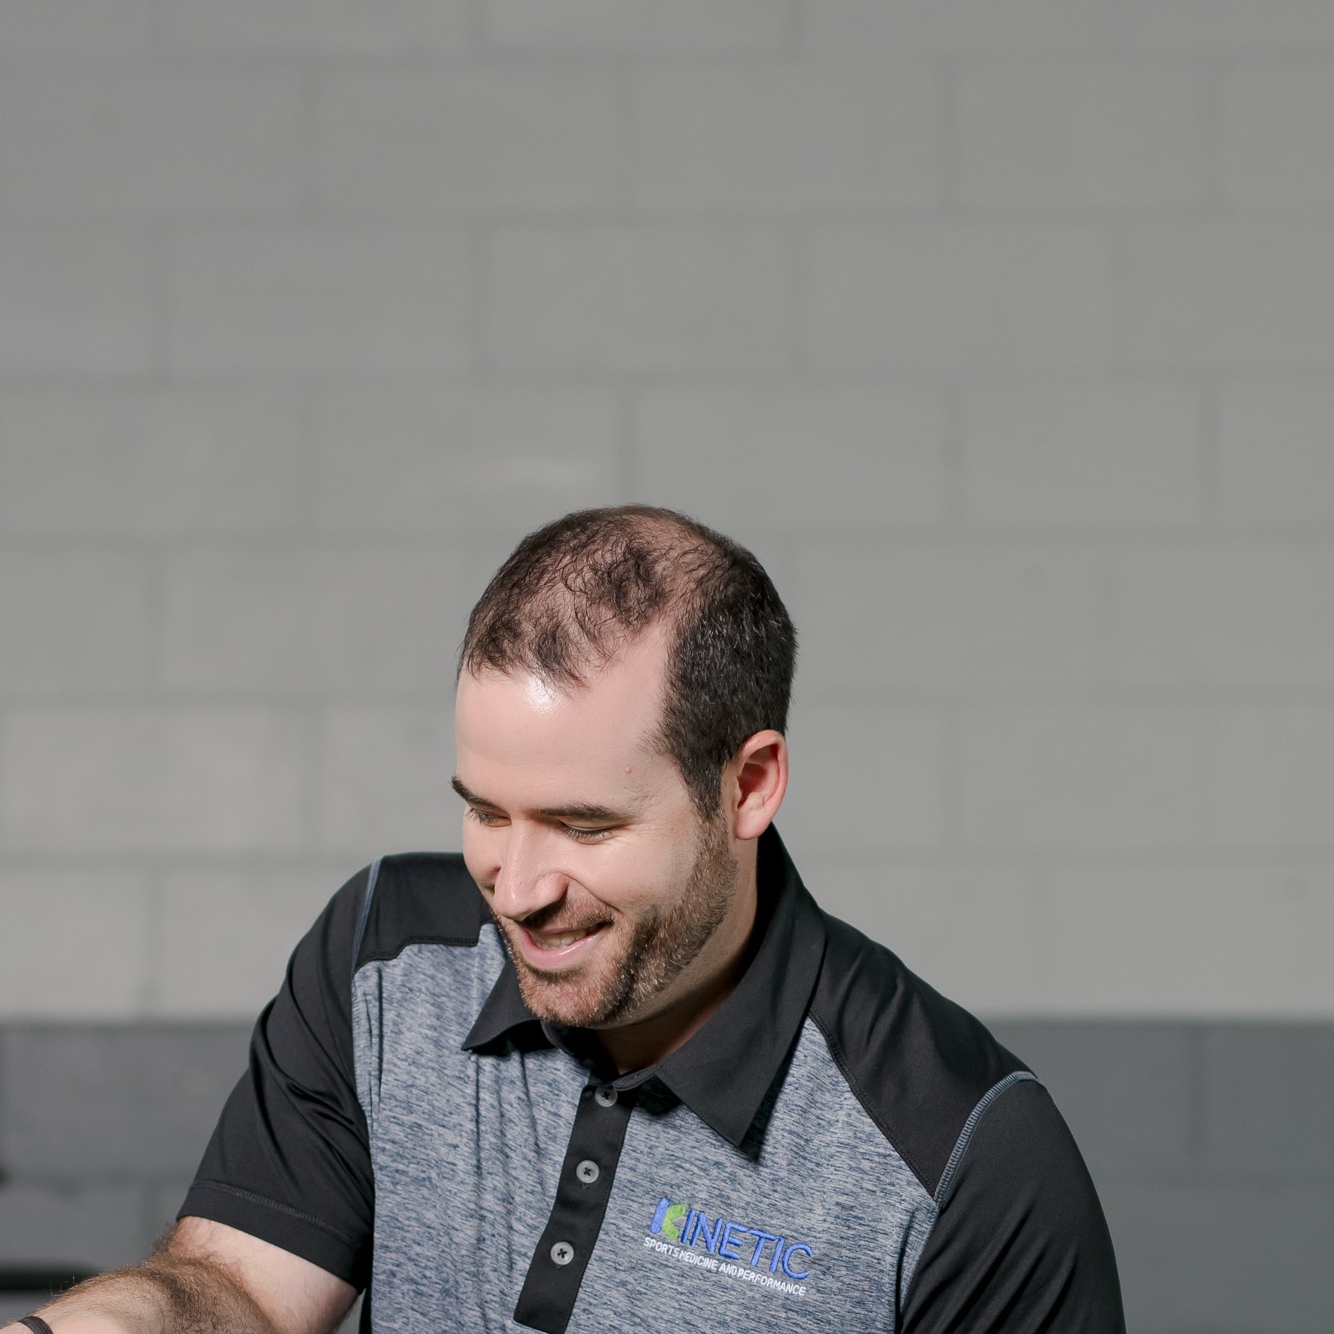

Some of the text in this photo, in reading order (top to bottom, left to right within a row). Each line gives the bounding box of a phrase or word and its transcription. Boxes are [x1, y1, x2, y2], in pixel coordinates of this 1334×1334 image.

[643, 1236, 807, 1297] SPORTS MEDICINE AND PERFORMANCE
[650, 1197, 814, 1280] KINETIC
